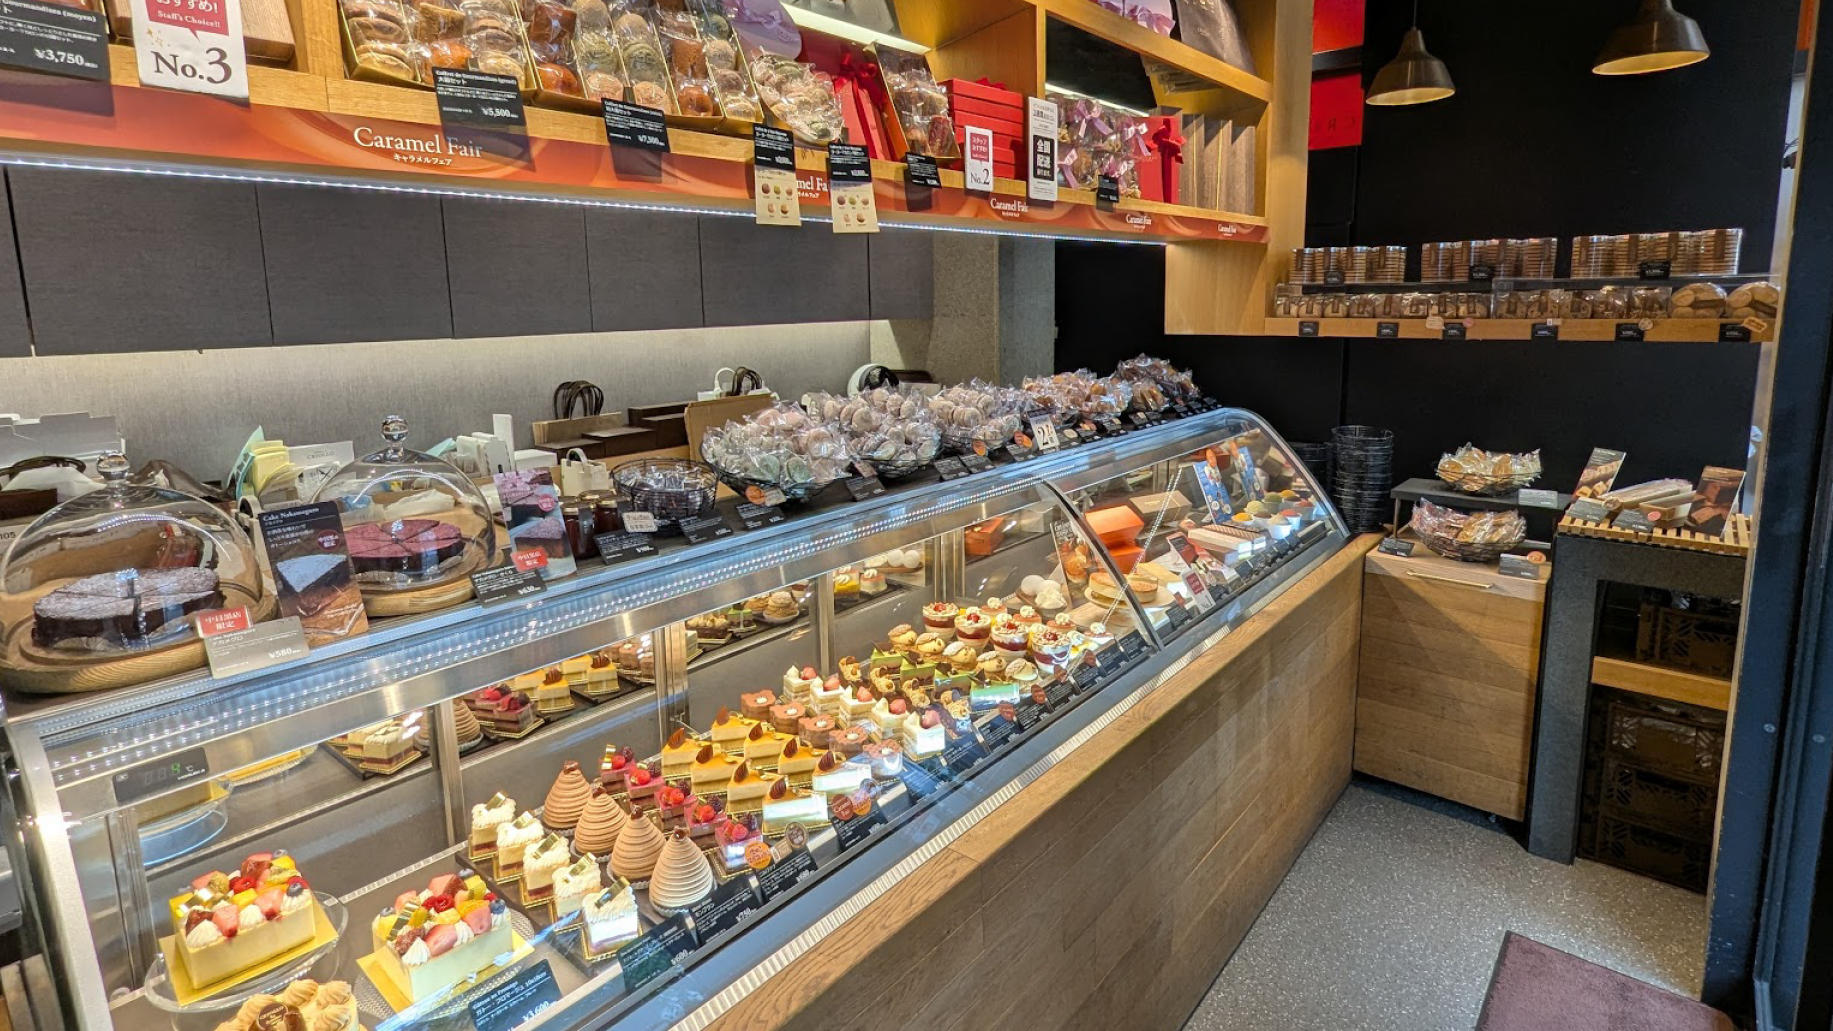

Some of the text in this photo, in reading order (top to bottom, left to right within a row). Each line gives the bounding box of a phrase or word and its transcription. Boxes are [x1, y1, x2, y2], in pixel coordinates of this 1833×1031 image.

[33, 48, 84, 65] ¥3,750
[150, 47, 232, 84] No.3
[353, 127, 483, 158] Caramel Fair
[393, 153, 453, 166] キャラメルフェア
[970, 168, 990, 185] No.2
[262, 513, 280, 522] Cake
[268, 647, 292, 659] ¥580
